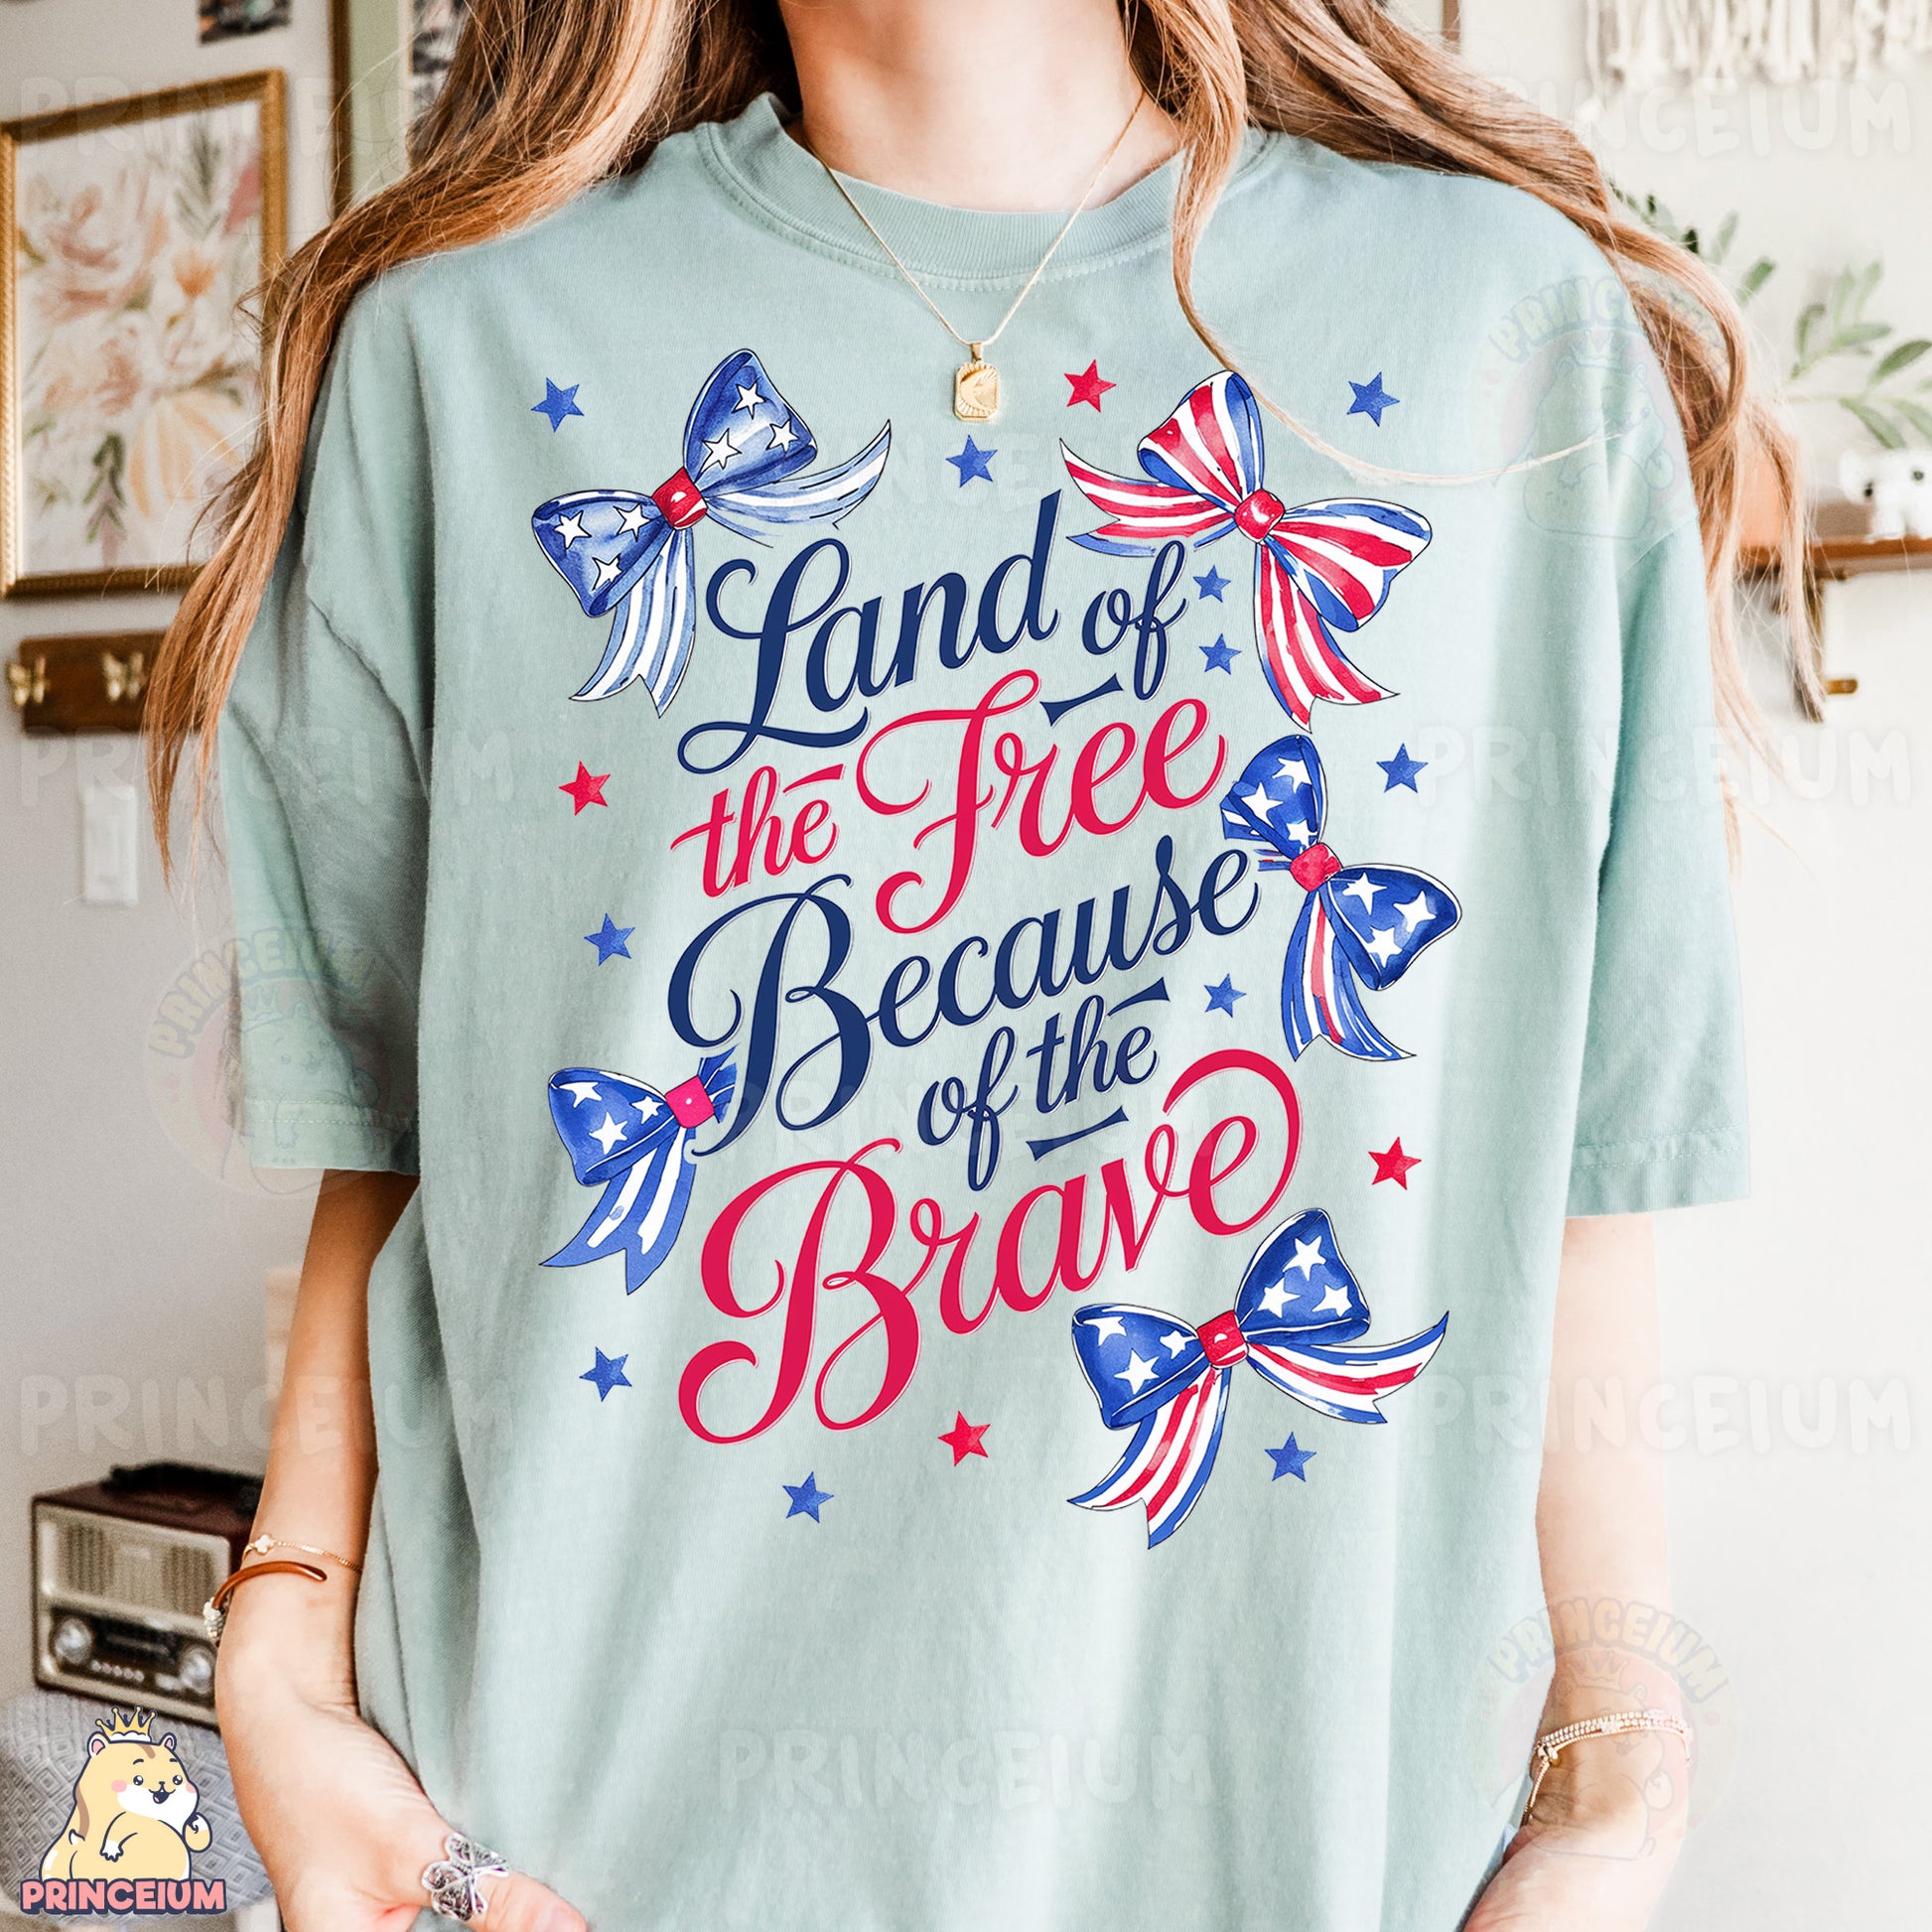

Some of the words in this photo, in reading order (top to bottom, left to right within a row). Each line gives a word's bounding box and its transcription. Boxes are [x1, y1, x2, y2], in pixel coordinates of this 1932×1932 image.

[678, 489, 1061, 774] Land
[1081, 539, 1187, 701] of
[670, 763, 844, 898] the
[856, 668, 1228, 935] Free
[667, 835, 1260, 1158] Because
[917, 1026, 1020, 1192] of
[1026, 993, 1170, 1115] the
[677, 1048, 1304, 1447] Brave
